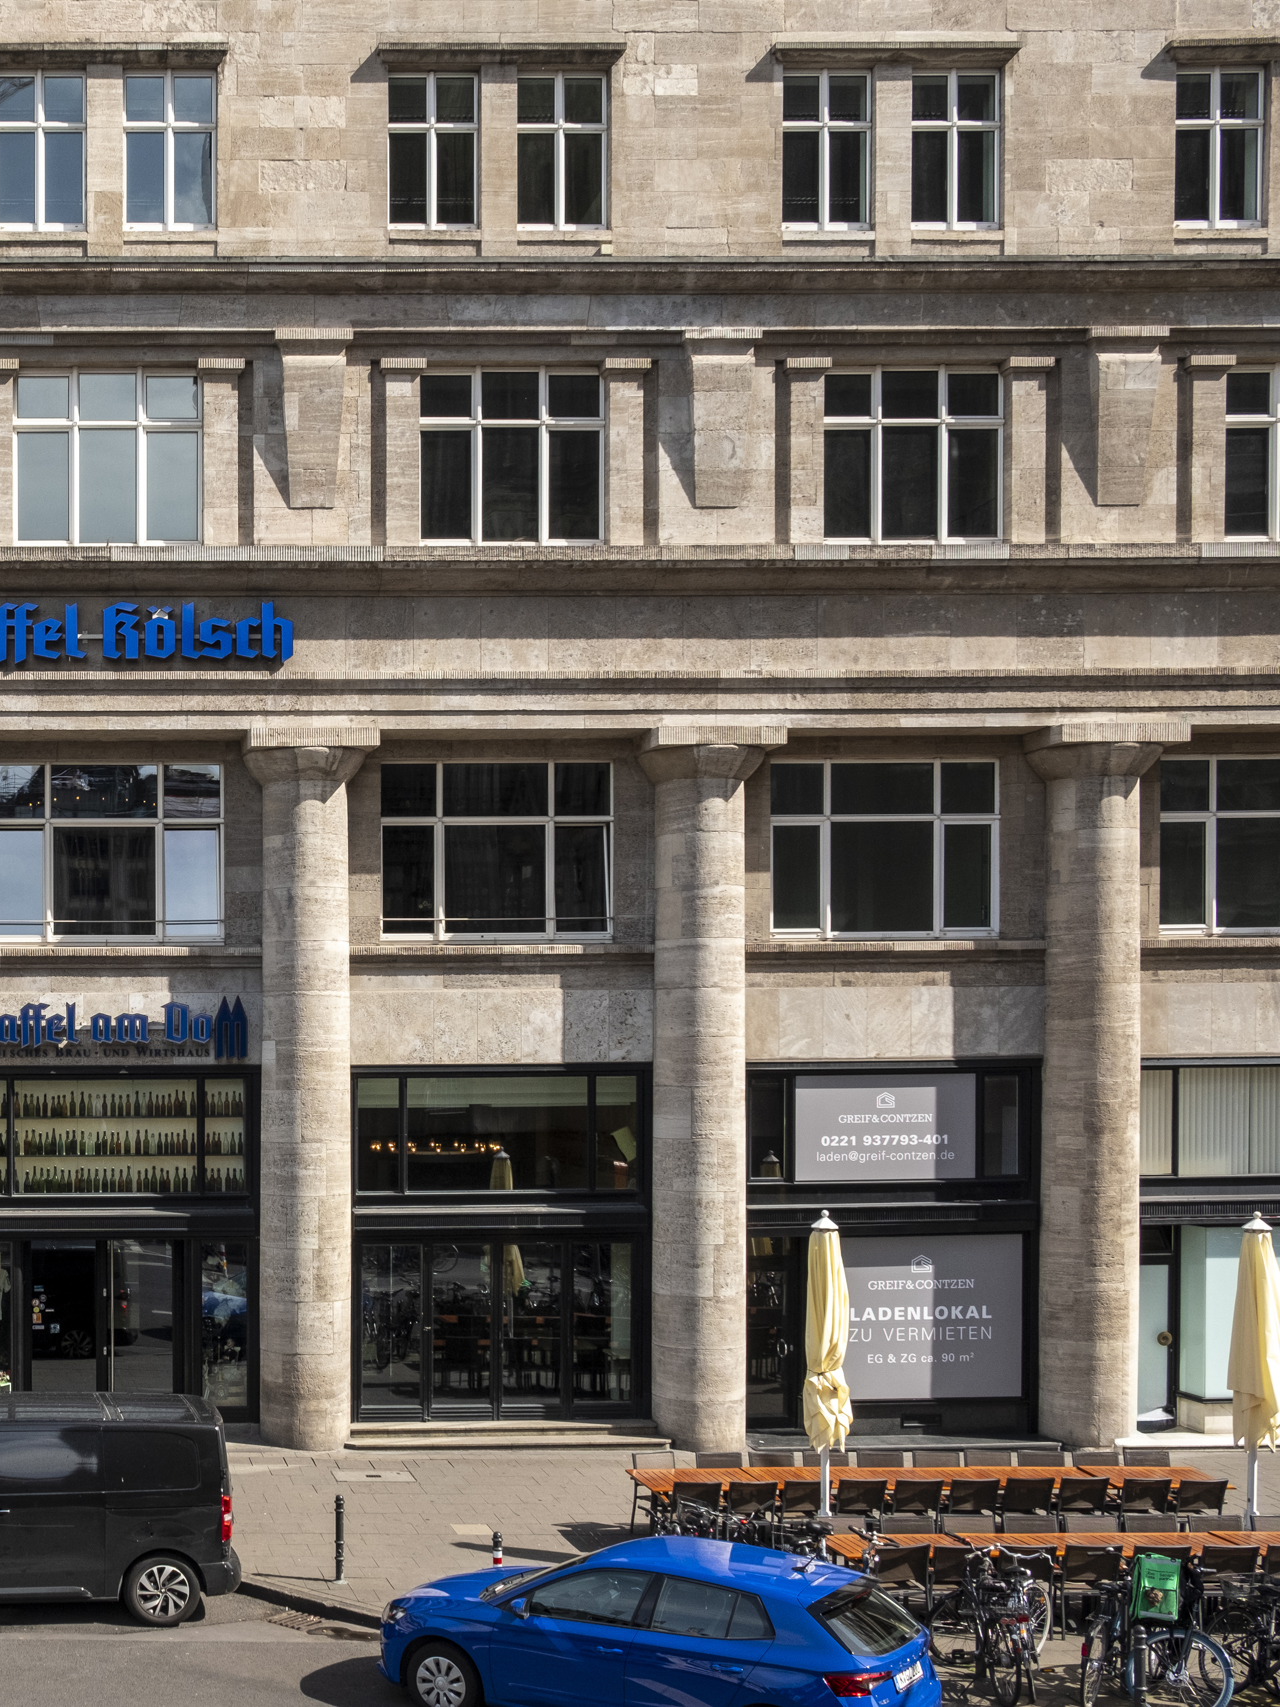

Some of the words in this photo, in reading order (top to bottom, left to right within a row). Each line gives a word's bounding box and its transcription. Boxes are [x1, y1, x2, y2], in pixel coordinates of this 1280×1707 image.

[102, 601, 294, 664] Kölsch
[90, 1012, 150, 1044] am
[838, 1113, 933, 1124] GREIF&CONTZEN
[821, 1135, 857, 1147] 0221
[862, 1134, 949, 1146] 937793-401
[816, 1150, 955, 1164] laden@greif-contzen.de
[868, 1278, 975, 1291] GREIF&CONTZEN
[850, 1305, 992, 1322] LADENLOKAL
[849, 1328, 872, 1342] ZU
[883, 1326, 992, 1341] VERMIETEN
[867, 1354, 883, 1364] EG
[887, 1354, 896, 1363] &
[900, 1353, 917, 1363] ZG
[921, 1354, 937, 1363] ca.
[941, 1353, 955, 1362] 90
